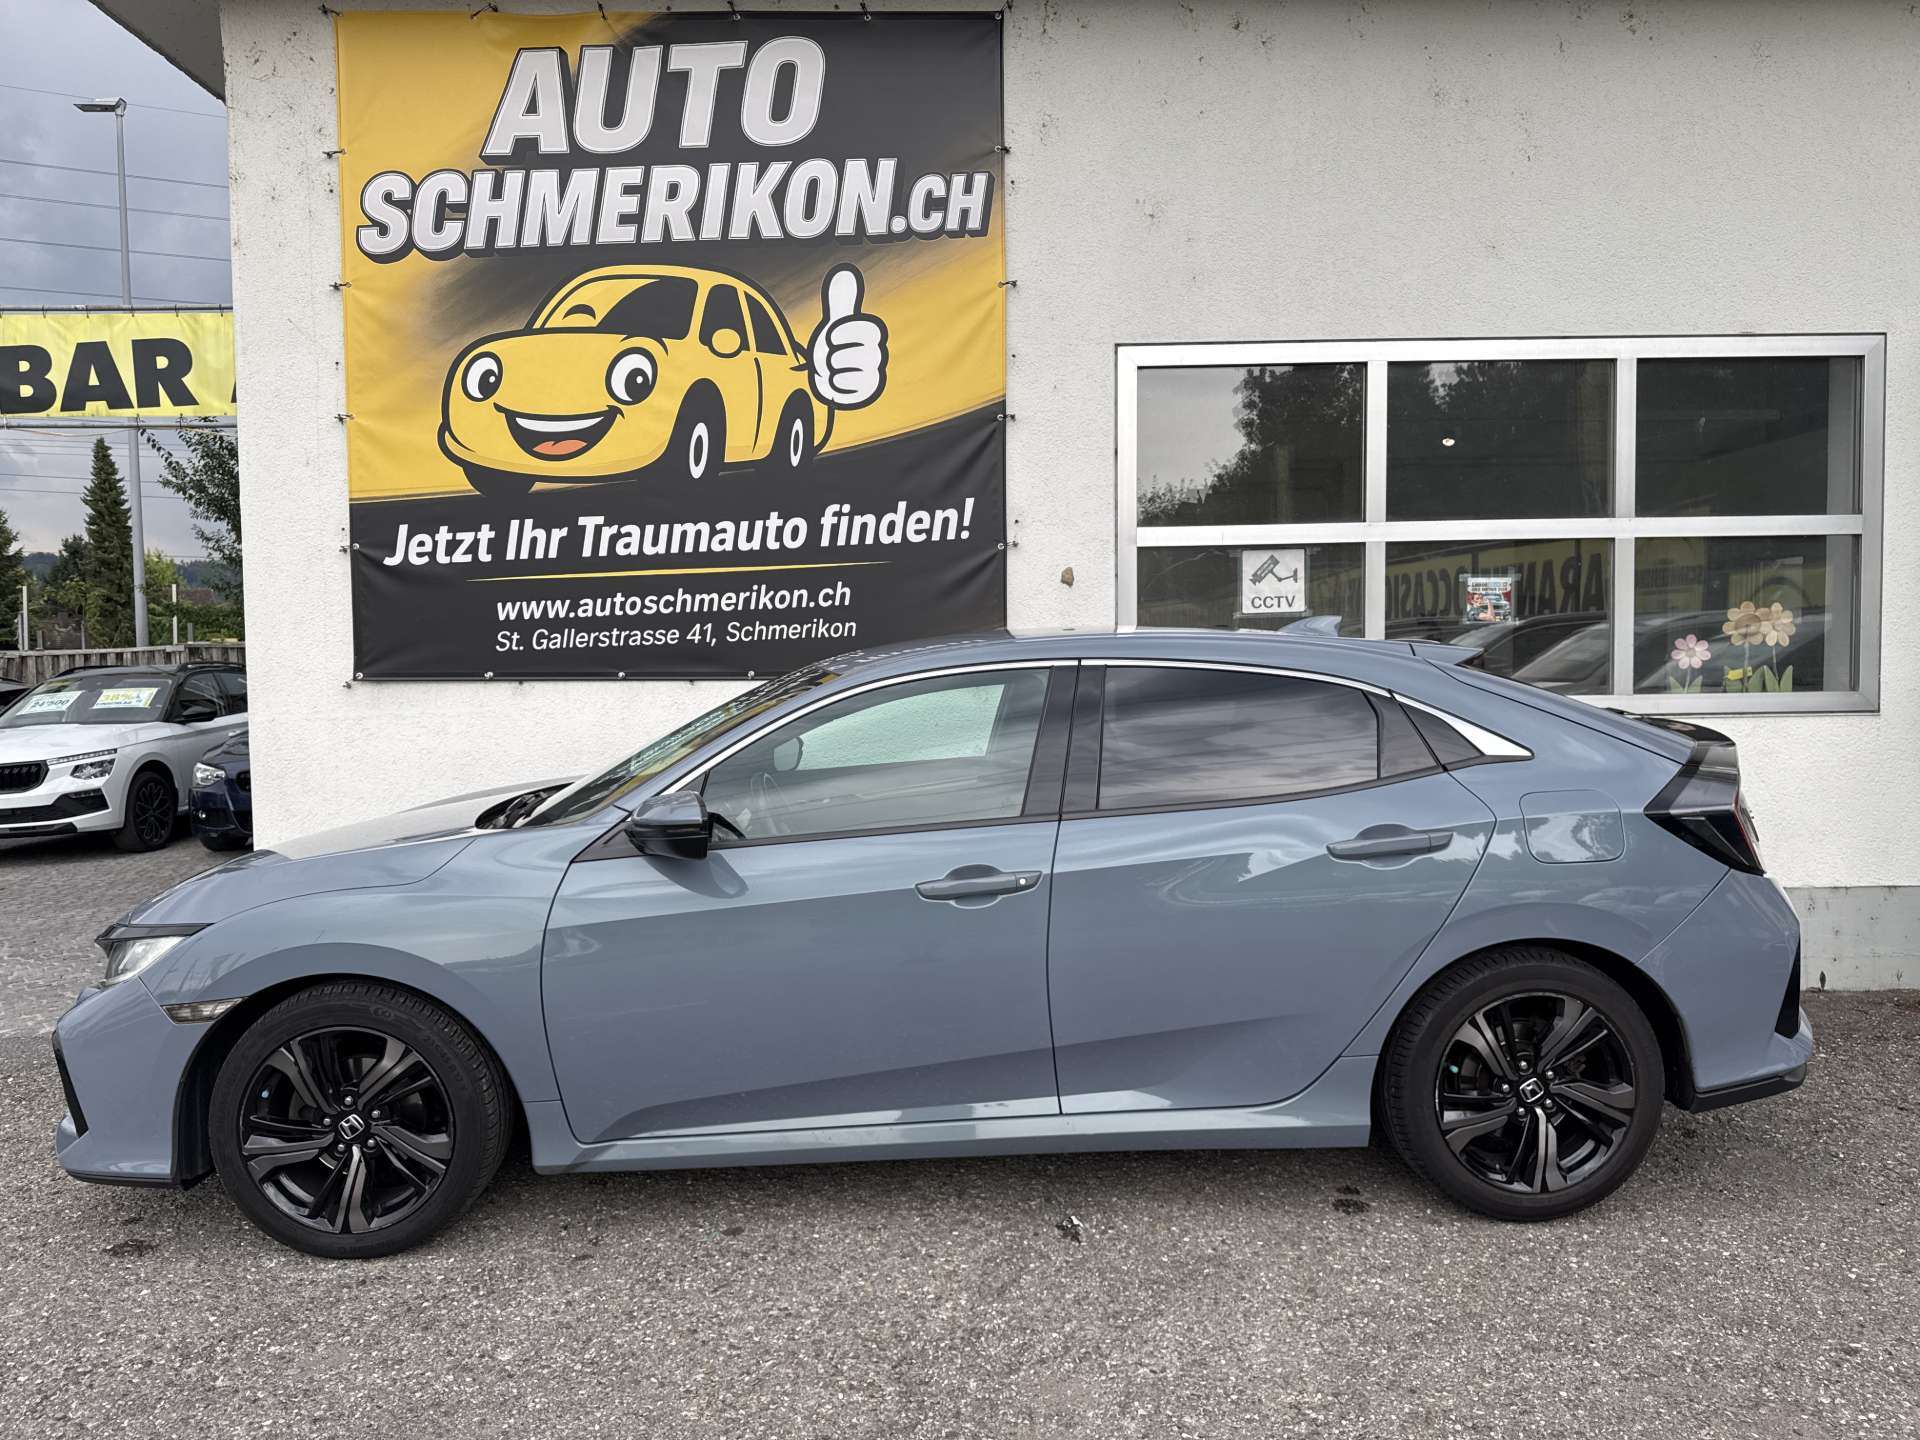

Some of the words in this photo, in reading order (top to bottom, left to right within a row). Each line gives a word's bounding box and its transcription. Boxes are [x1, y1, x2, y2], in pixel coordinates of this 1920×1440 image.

[480, 34, 826, 157] AUTO
[358, 157, 990, 255] SCHMERIKON.CH
[0, 337, 200, 414] BAR
[382, 523, 496, 567] Jetzt
[505, 518, 568, 561] Ihr
[577, 511, 809, 558] Traumauto
[819, 497, 976, 548] finden!
[495, 630, 525, 652] St.
[531, 627, 680, 651] Gallerstrasse
[685, 622, 718, 647] 41,
[725, 618, 857, 643] Schmerikon
[496, 581, 852, 621] www.autoschmerikon.ch
[1250, 595, 1296, 609] CCTV
